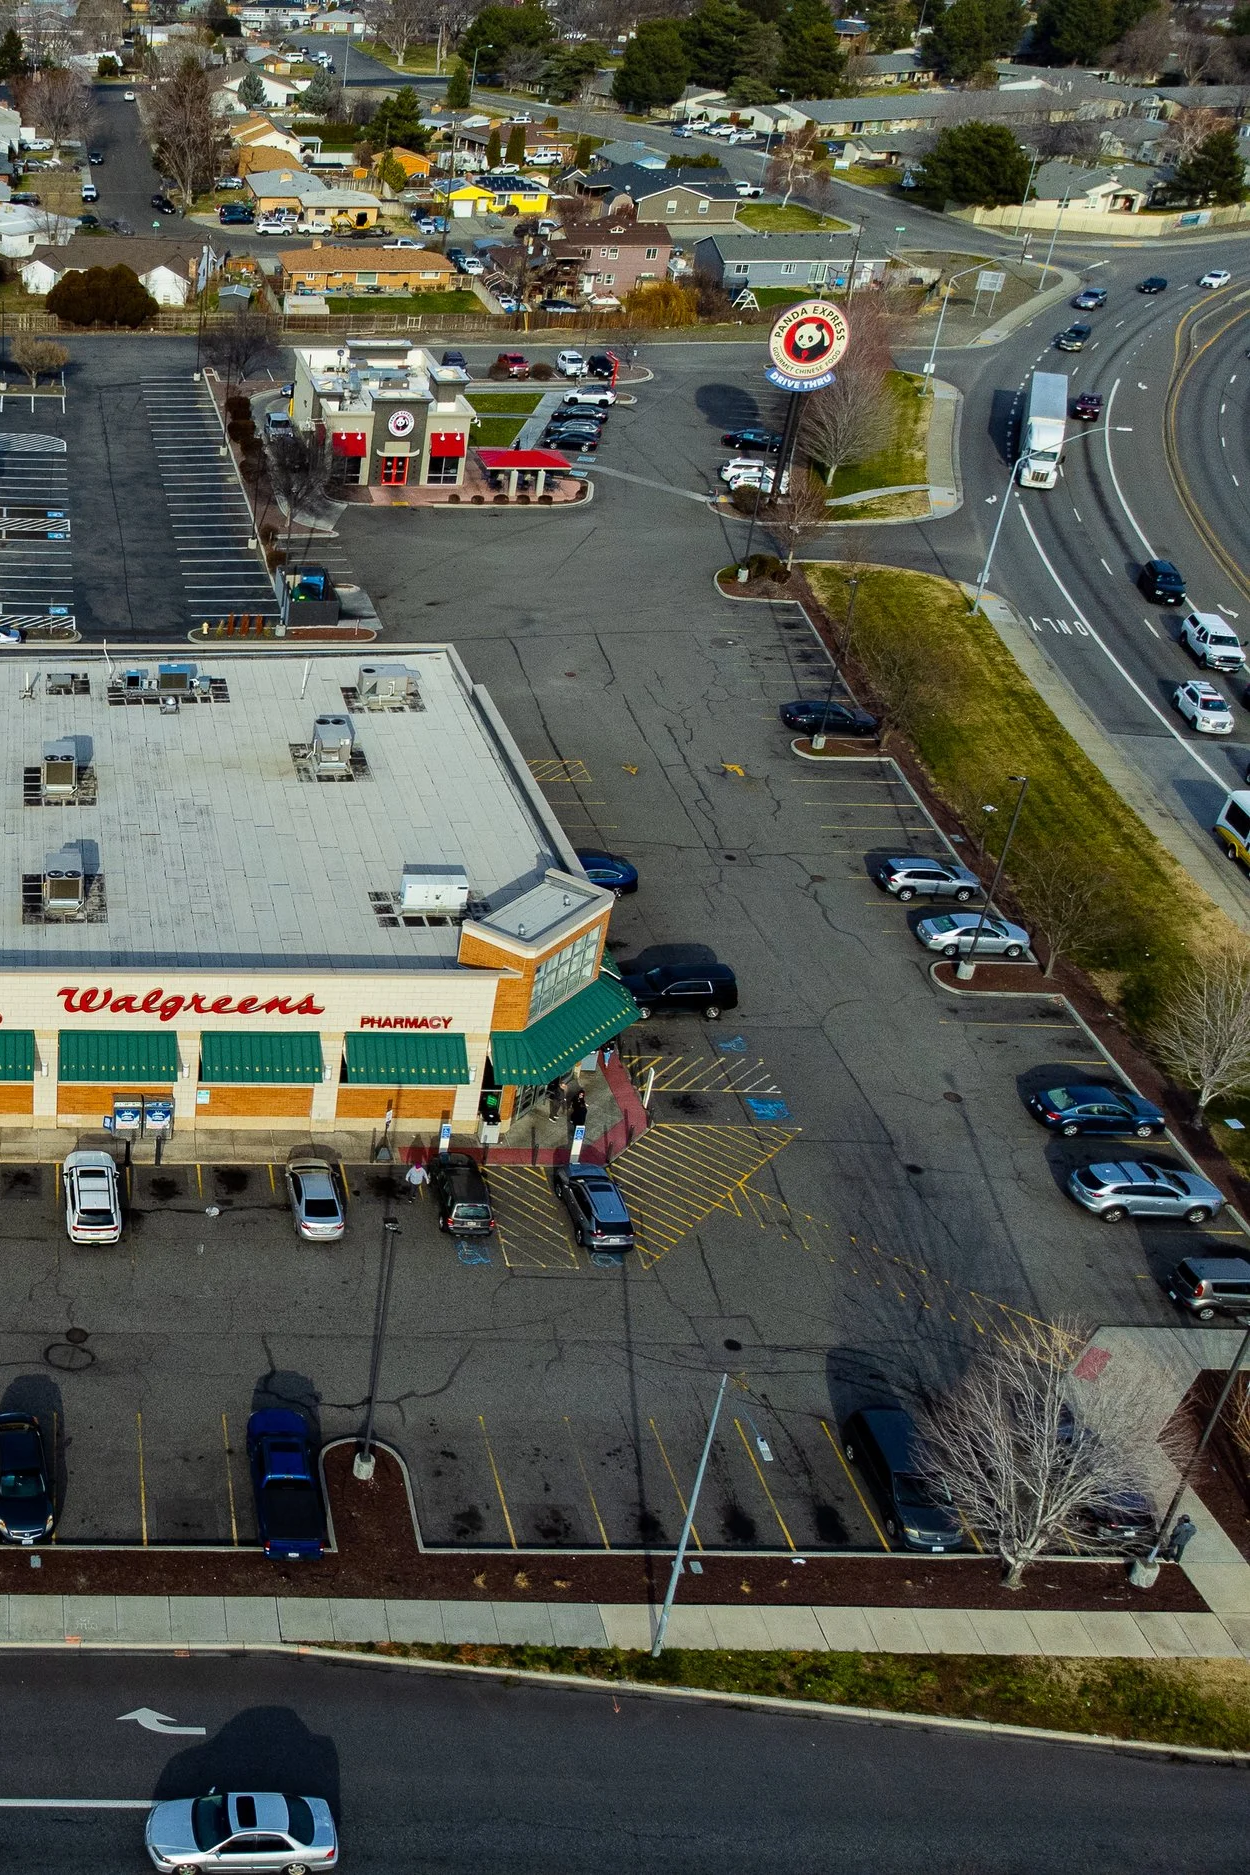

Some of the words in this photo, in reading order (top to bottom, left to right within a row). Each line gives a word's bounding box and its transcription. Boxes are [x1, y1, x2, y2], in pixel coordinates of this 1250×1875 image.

[774, 307, 808, 338] PANDA
[812, 305, 845, 341] EXPRESS
[772, 346, 794, 372] GOURMET
[794, 365, 824, 375] CHINESE
[825, 350, 841, 367] FOOD
[770, 371, 800, 389] DRIVE
[802, 374, 832, 389] THRU
[1028, 616, 1090, 637] ONLY
[57, 985, 326, 1022] Walgreens
[359, 1015, 453, 1030] PHARMACY
